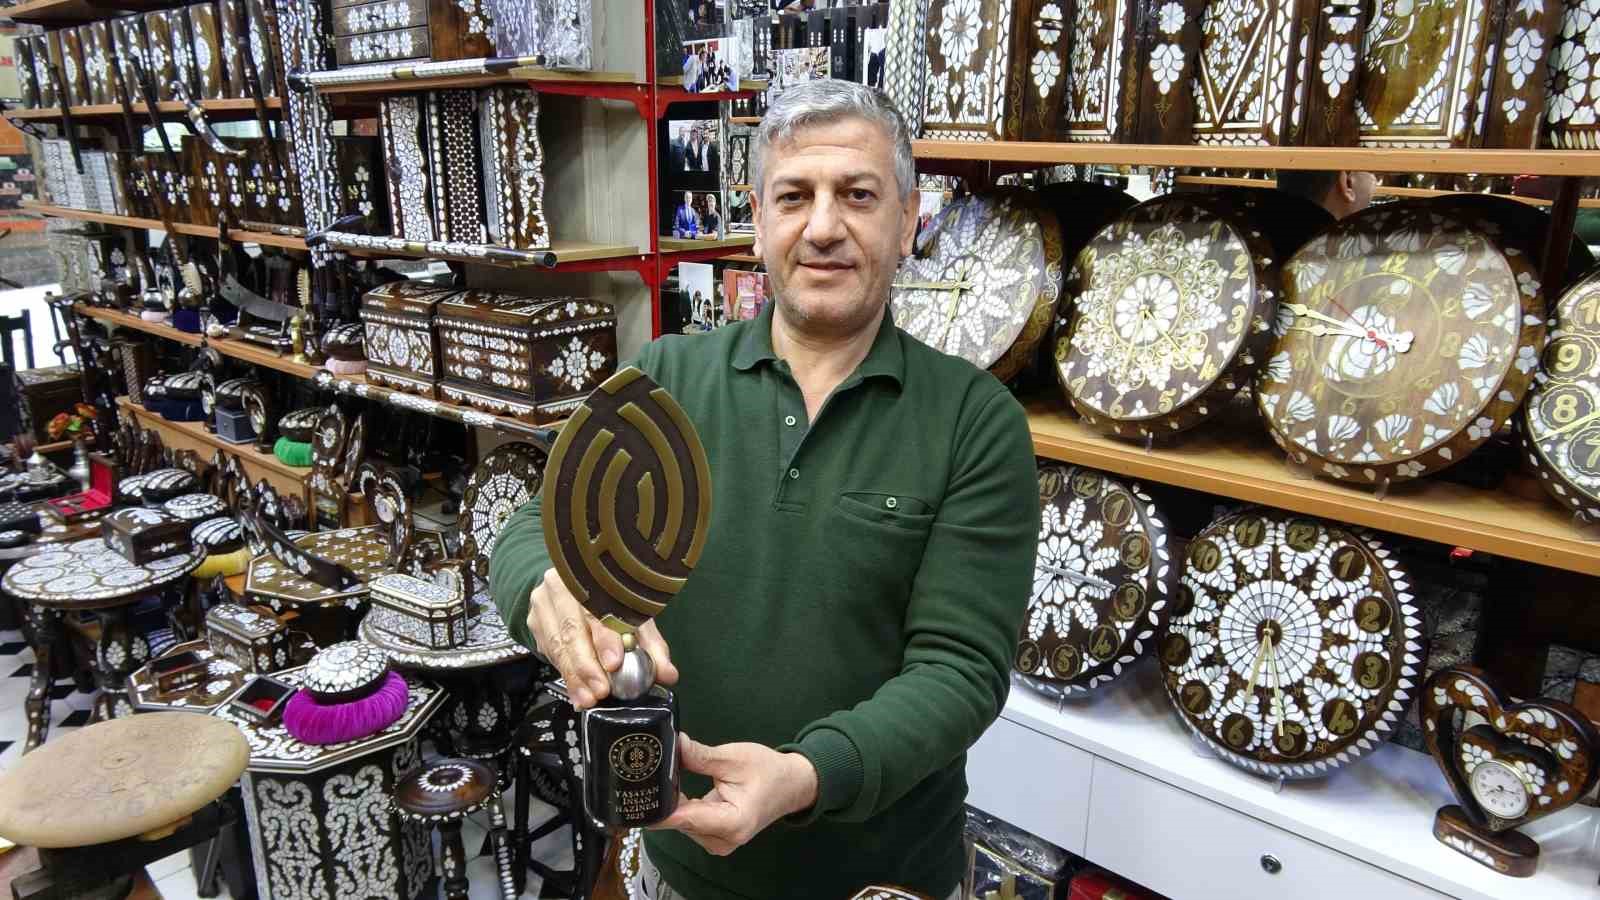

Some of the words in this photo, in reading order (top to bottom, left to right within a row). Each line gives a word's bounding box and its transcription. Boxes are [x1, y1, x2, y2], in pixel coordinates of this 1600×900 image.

[1230, 254, 1249, 280] 2
[1380, 253, 1408, 273] 12
[1227, 305, 1245, 334] 3
[1579, 298, 1600, 325] 1
[1055, 336, 1069, 361] 8
[1555, 344, 1582, 372] 9
[1199, 354, 1217, 380] 4
[1071, 376, 1087, 398] 7
[1109, 395, 1123, 418] 6
[1159, 388, 1177, 413] 5
[1553, 394, 1578, 423] 8
[1077, 474, 1098, 494] 12
[1111, 500, 1124, 521] 1
[1234, 519, 1261, 547] 11
[1287, 523, 1316, 547] 12
[1126, 541, 1141, 566] 2
[1195, 543, 1218, 573] 10
[1339, 550, 1354, 577] 1
[1120, 587, 1139, 615] 3
[1360, 601, 1380, 631] 2
[1092, 629, 1111, 655] 4
[1020, 647, 1033, 671] 6
[1057, 648, 1074, 673] 5
[1360, 656, 1382, 688] 3
[1186, 685, 1206, 711] 7
[1328, 702, 1354, 733] 4
[1228, 718, 1246, 745] 6
[1278, 724, 1301, 752] 5
